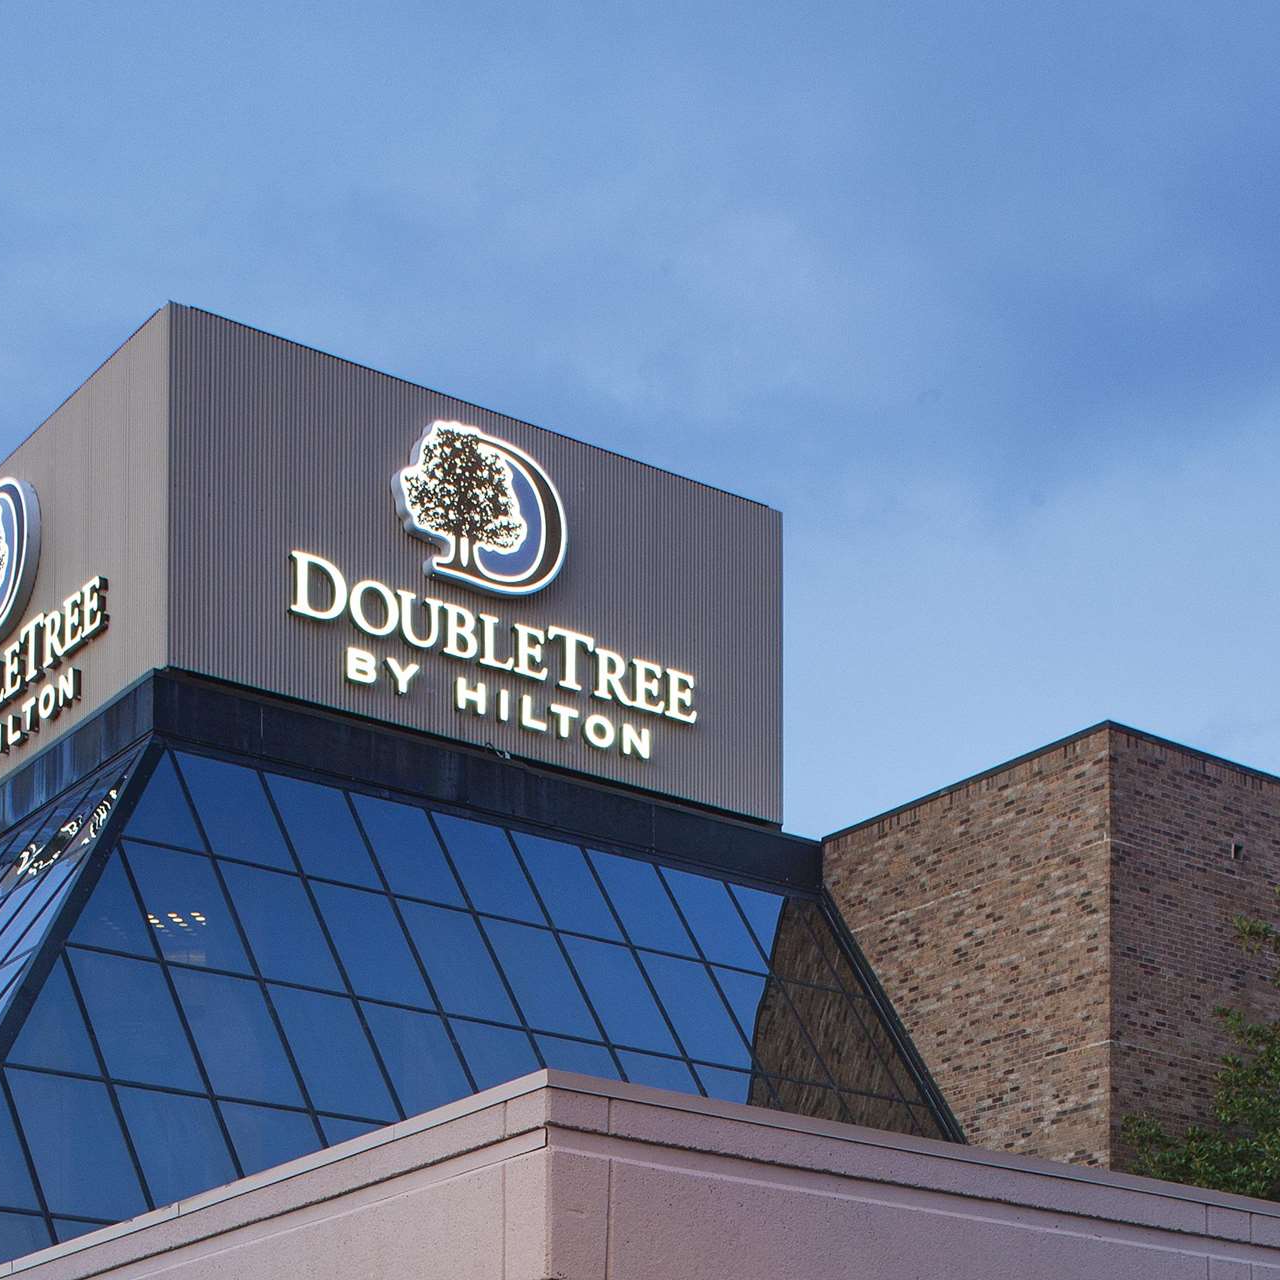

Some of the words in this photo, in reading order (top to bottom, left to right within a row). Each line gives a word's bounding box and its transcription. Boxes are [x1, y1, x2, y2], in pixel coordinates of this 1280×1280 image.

[290, 550, 698, 724] DOUBLETREE
[345, 647, 419, 694] BY
[455, 677, 651, 760] HILTON
